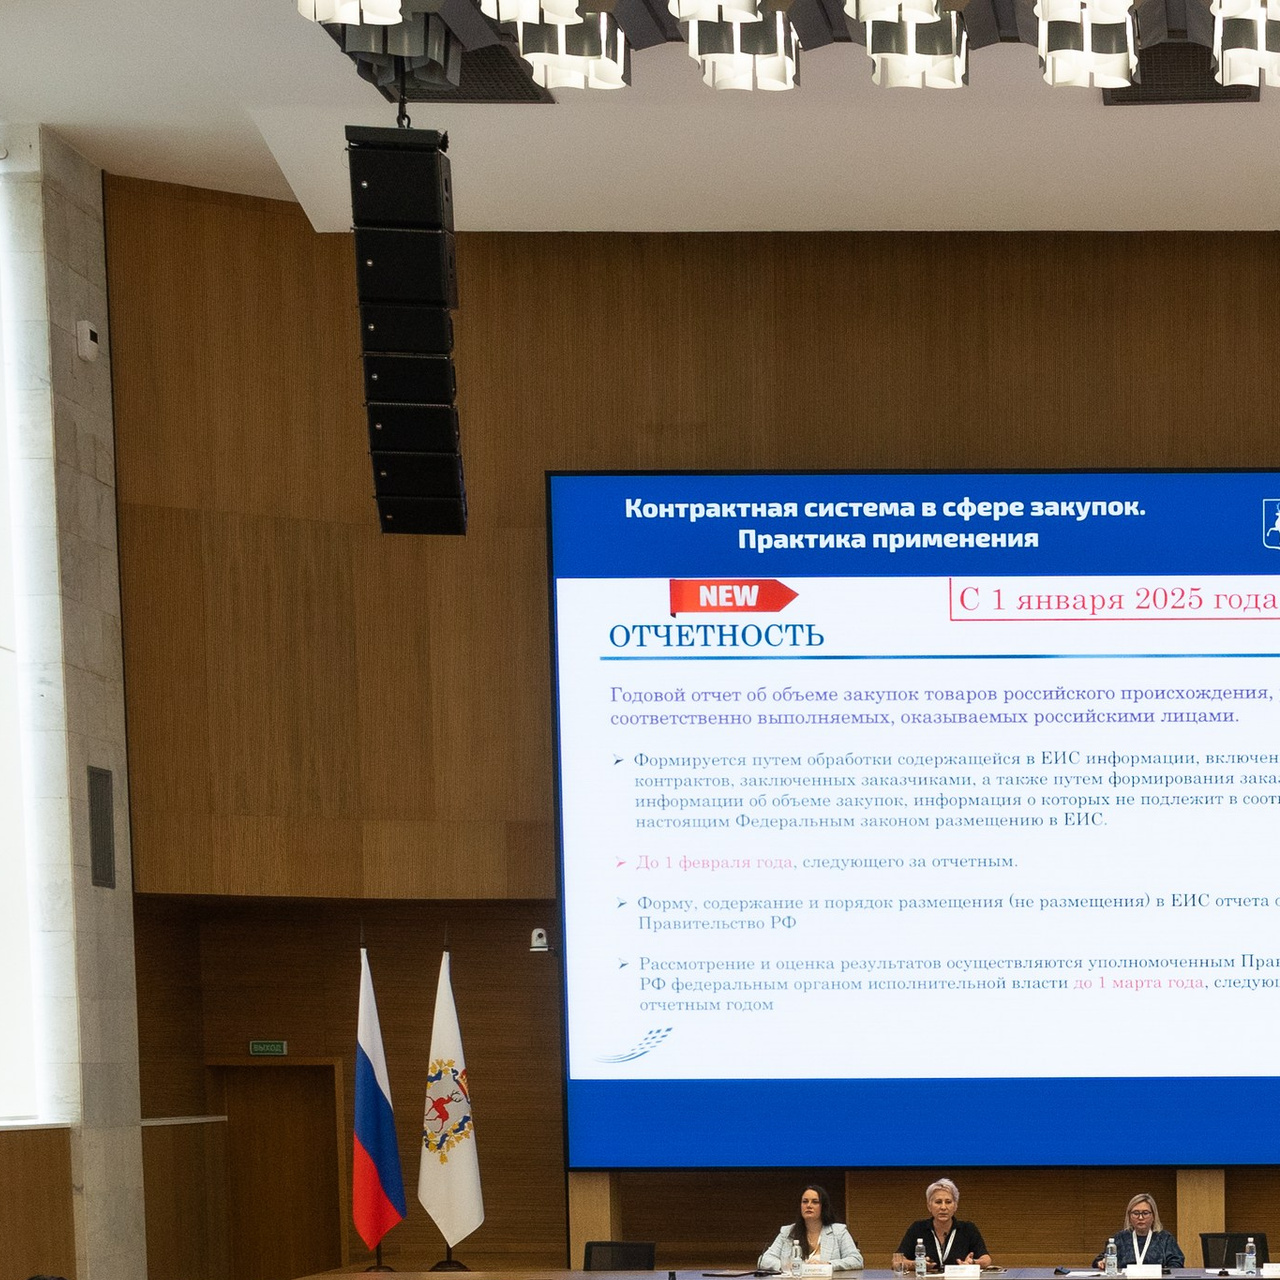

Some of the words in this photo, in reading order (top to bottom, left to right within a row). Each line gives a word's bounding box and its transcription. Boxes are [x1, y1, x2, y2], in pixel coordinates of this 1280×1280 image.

[625, 498, 798, 523] Контрактная
[804, 501, 916, 518] система
[921, 501, 937, 517] в
[942, 496, 1025, 522] сфере
[1030, 500, 1146, 522] закупок.
[738, 528, 867, 554] Практика
[872, 532, 1039, 554] применения
[699, 584, 759, 608] NEW
[959, 586, 979, 611] С
[1016, 594, 1125, 615] января
[1135, 587, 1204, 610] 2025
[609, 623, 825, 648] ОТЧЕТНОСТЬ
[610, 686, 686, 705] Годовой
[691, 691, 742, 702] отчет
[746, 686, 767, 702] об
[772, 686, 838, 702] объеме
[843, 690, 919, 705] закупок
[924, 689, 998, 705] товаров
[1003, 685, 1116, 704] российского
[1120, 688, 1274, 704] происхождения,
[610, 714, 752, 726] соответственно
[757, 713, 895, 727] выполняемых,
[900, 712, 1029, 724] оказываемых
[1033, 708, 1156, 727] российскими
[1160, 711, 1239, 725] лицами.
[633, 752, 746, 770] Формируется
[752, 756, 802, 770] путем
[807, 751, 892, 769] обработки
[897, 752, 1021, 769] содержащейся
[1026, 755, 1036, 765] в
[1041, 750, 1081, 765] ЕИС
[1086, 750, 1200, 768] информации,
[635, 777, 735, 790] контрактов,
[739, 776, 856, 787] заключенных
[861, 776, 977, 787] заказчиками,
[982, 776, 991, 786] а
[995, 775, 1048, 786] также
[1054, 775, 1103, 789] путем
[1108, 770, 1234, 788] формирования
[635, 793, 744, 811] информации
[749, 793, 767, 807] об
[771, 793, 831, 807] объеме
[835, 797, 908, 810] закупок,
[914, 792, 1022, 810] информация
[1027, 796, 1037, 806] о
[1041, 795, 1110, 809] которых
[1115, 795, 1135, 806] не
[1140, 795, 1224, 807] подлежит
[1229, 795, 1238, 805] в
[636, 818, 730, 829] настоящим
[735, 813, 855, 831] Федеральным
[860, 817, 930, 827] законом
[935, 816, 1044, 830] размещению
[1049, 816, 1058, 826] в
[1064, 811, 1108, 826] ЕИС.
[635, 855, 659, 870] До
[678, 855, 751, 872] февраля
[757, 859, 798, 870] года,
[802, 858, 905, 871] следующего
[908, 858, 927, 868] за
[931, 857, 1018, 868] отчетным.
[637, 896, 698, 913] Форму,
[703, 899, 804, 913] содержание
[809, 899, 819, 909] и
[824, 899, 893, 912] порядок
[898, 898, 1004, 912] размещения
[1008, 893, 1035, 908] (не
[1039, 892, 1151, 911] размещения)
[1156, 897, 1165, 908] в
[1171, 893, 1210, 908] ЕИС
[1215, 897, 1270, 907] отчета
[638, 915, 765, 933] Правительство
[770, 915, 797, 929] РФ
[639, 956, 755, 974] Рассмотрение
[760, 960, 770, 970] и
[775, 960, 835, 971] оценка
[840, 959, 942, 973] результатов
[946, 959, 1083, 972] осуществляются
[1087, 958, 1235, 972] уполномоченным
[640, 976, 667, 991] РФ
[670, 976, 789, 994] федеральным
[793, 980, 863, 993] органом
[868, 976, 1006, 990] исполнительной
[1011, 979, 1068, 990] власти
[1073, 979, 1093, 990] до
[1112, 979, 1162, 992] марта
[1168, 978, 1209, 990] года,
[639, 1001, 721, 1011] отчетным
[726, 1000, 774, 1012] годом
